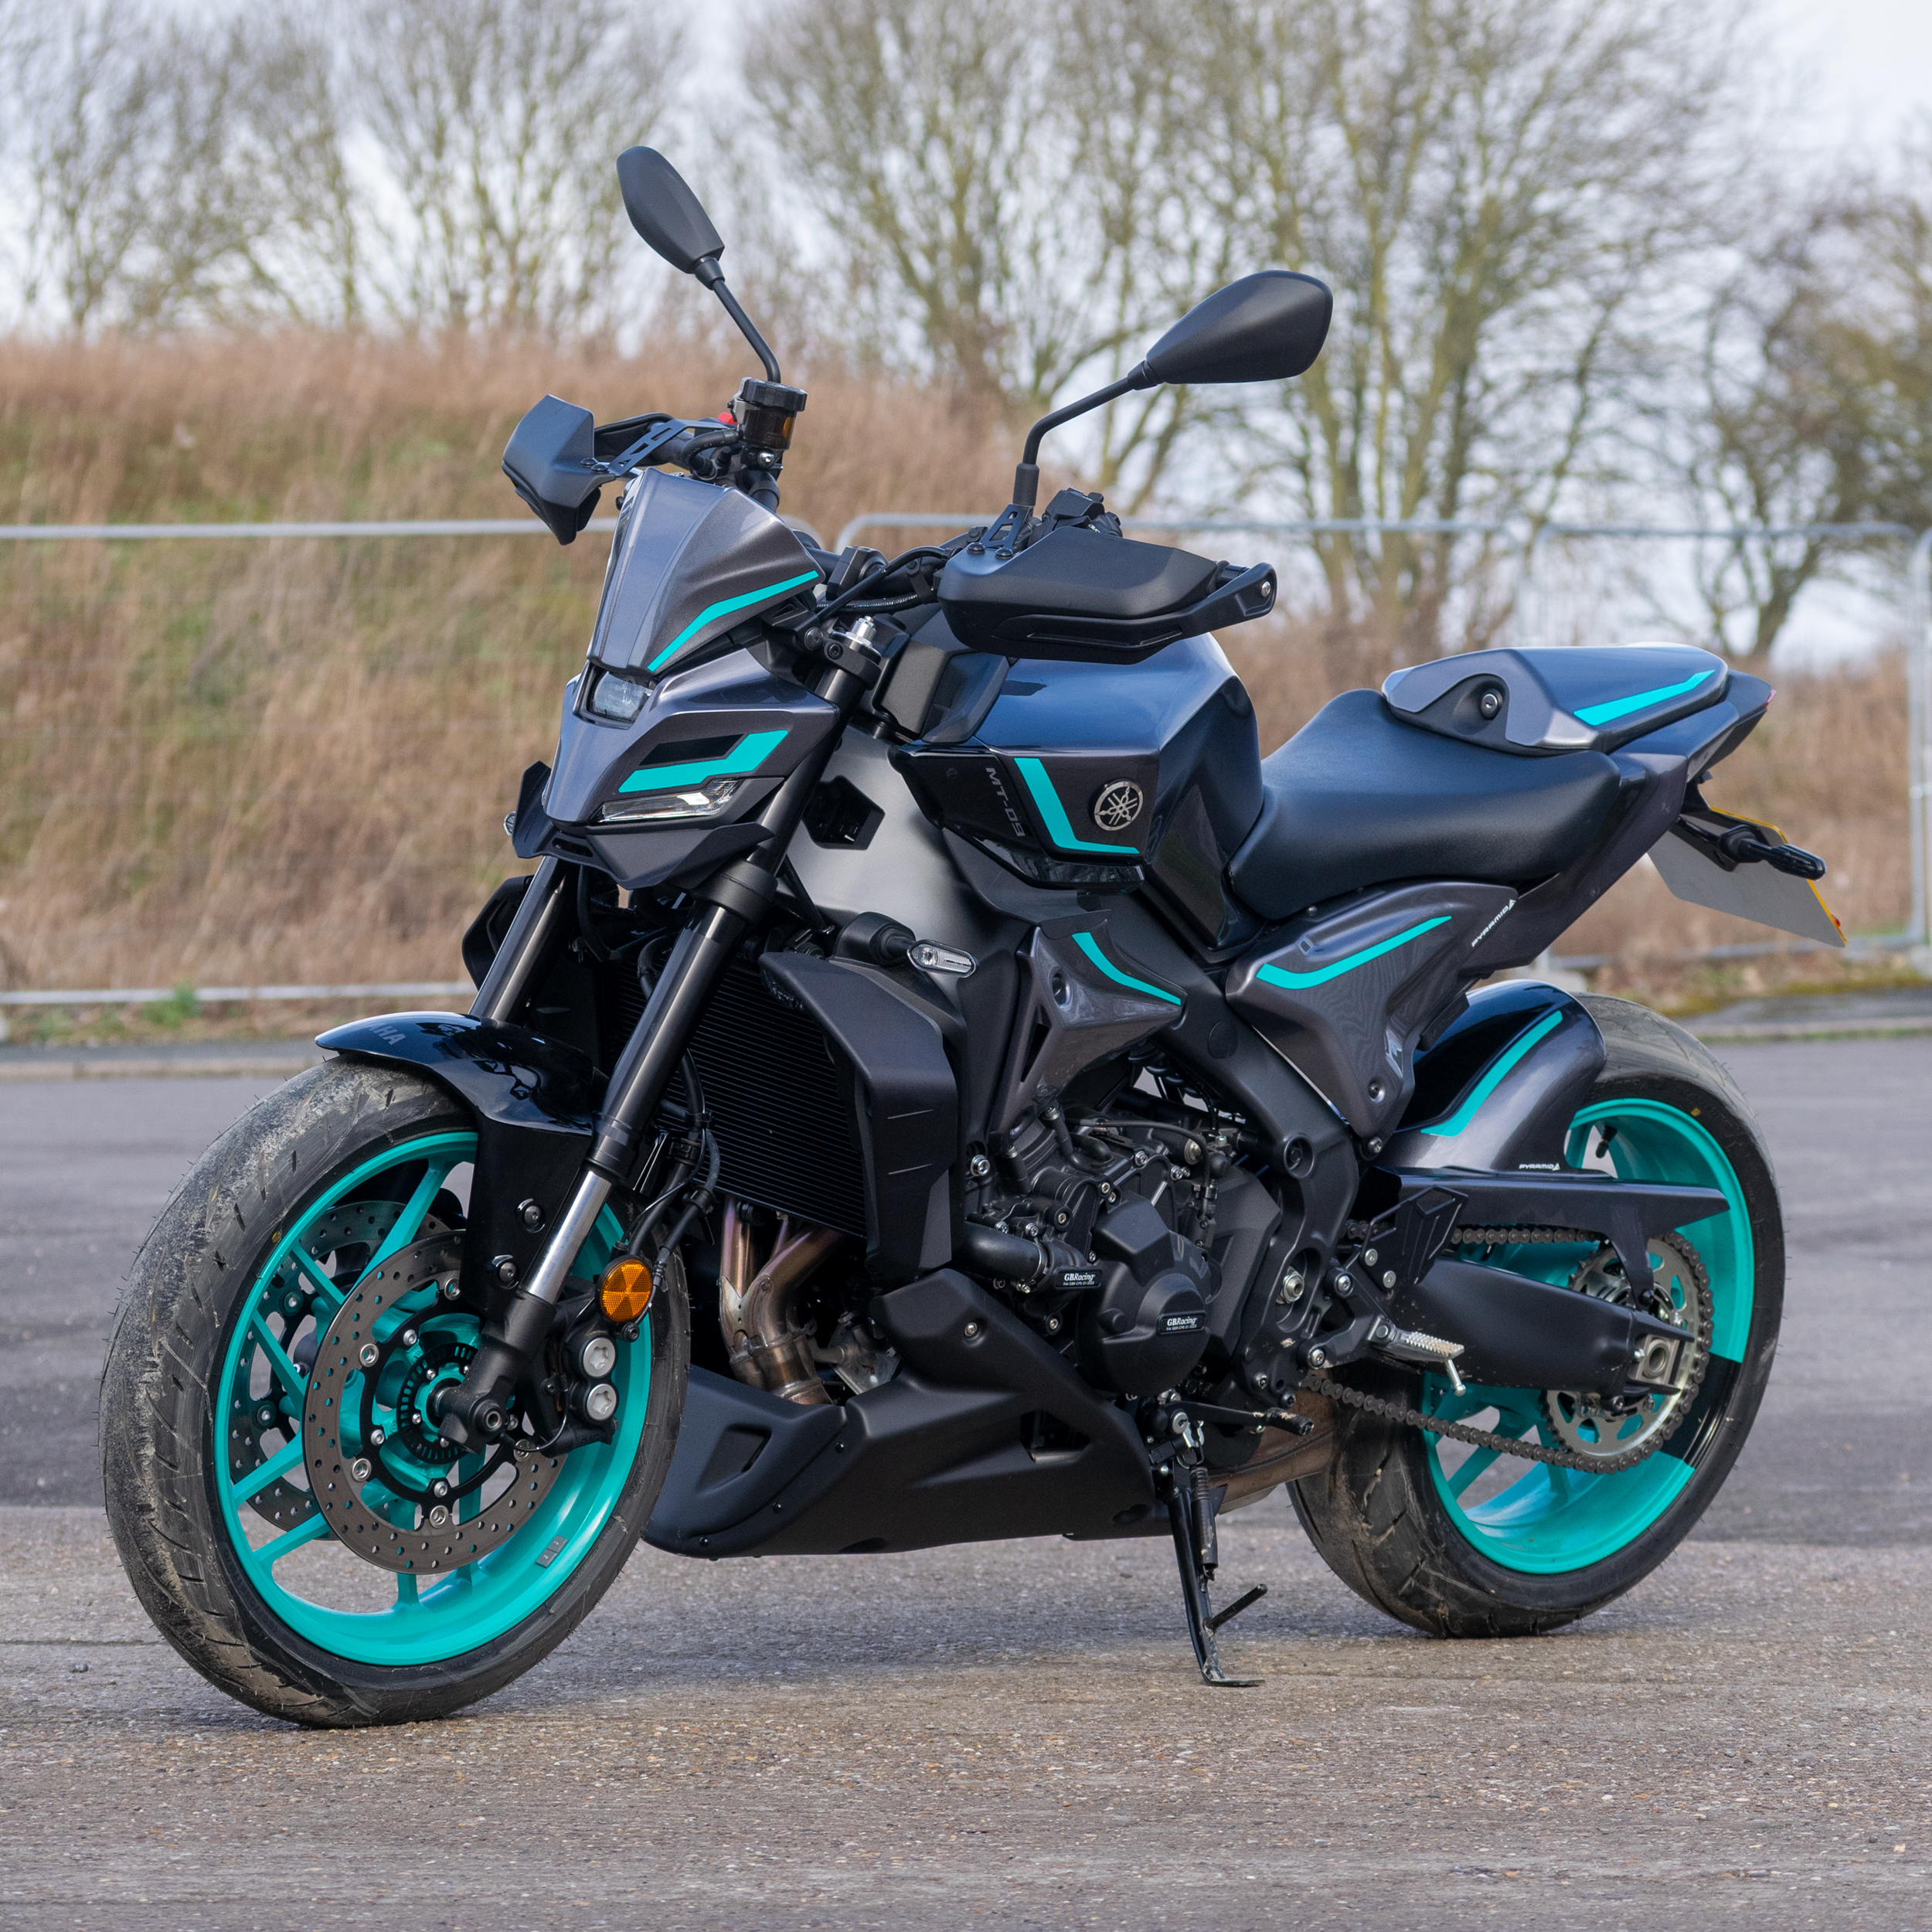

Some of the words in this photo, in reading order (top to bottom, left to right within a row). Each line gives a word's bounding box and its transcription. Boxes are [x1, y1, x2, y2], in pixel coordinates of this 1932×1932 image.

[985, 767, 1026, 837] MT-09
[1471, 903, 1510, 947] PYRAMID
[1064, 1272, 1094, 1282] GBRacing
[1167, 1316, 1197, 1327] GBRacing
